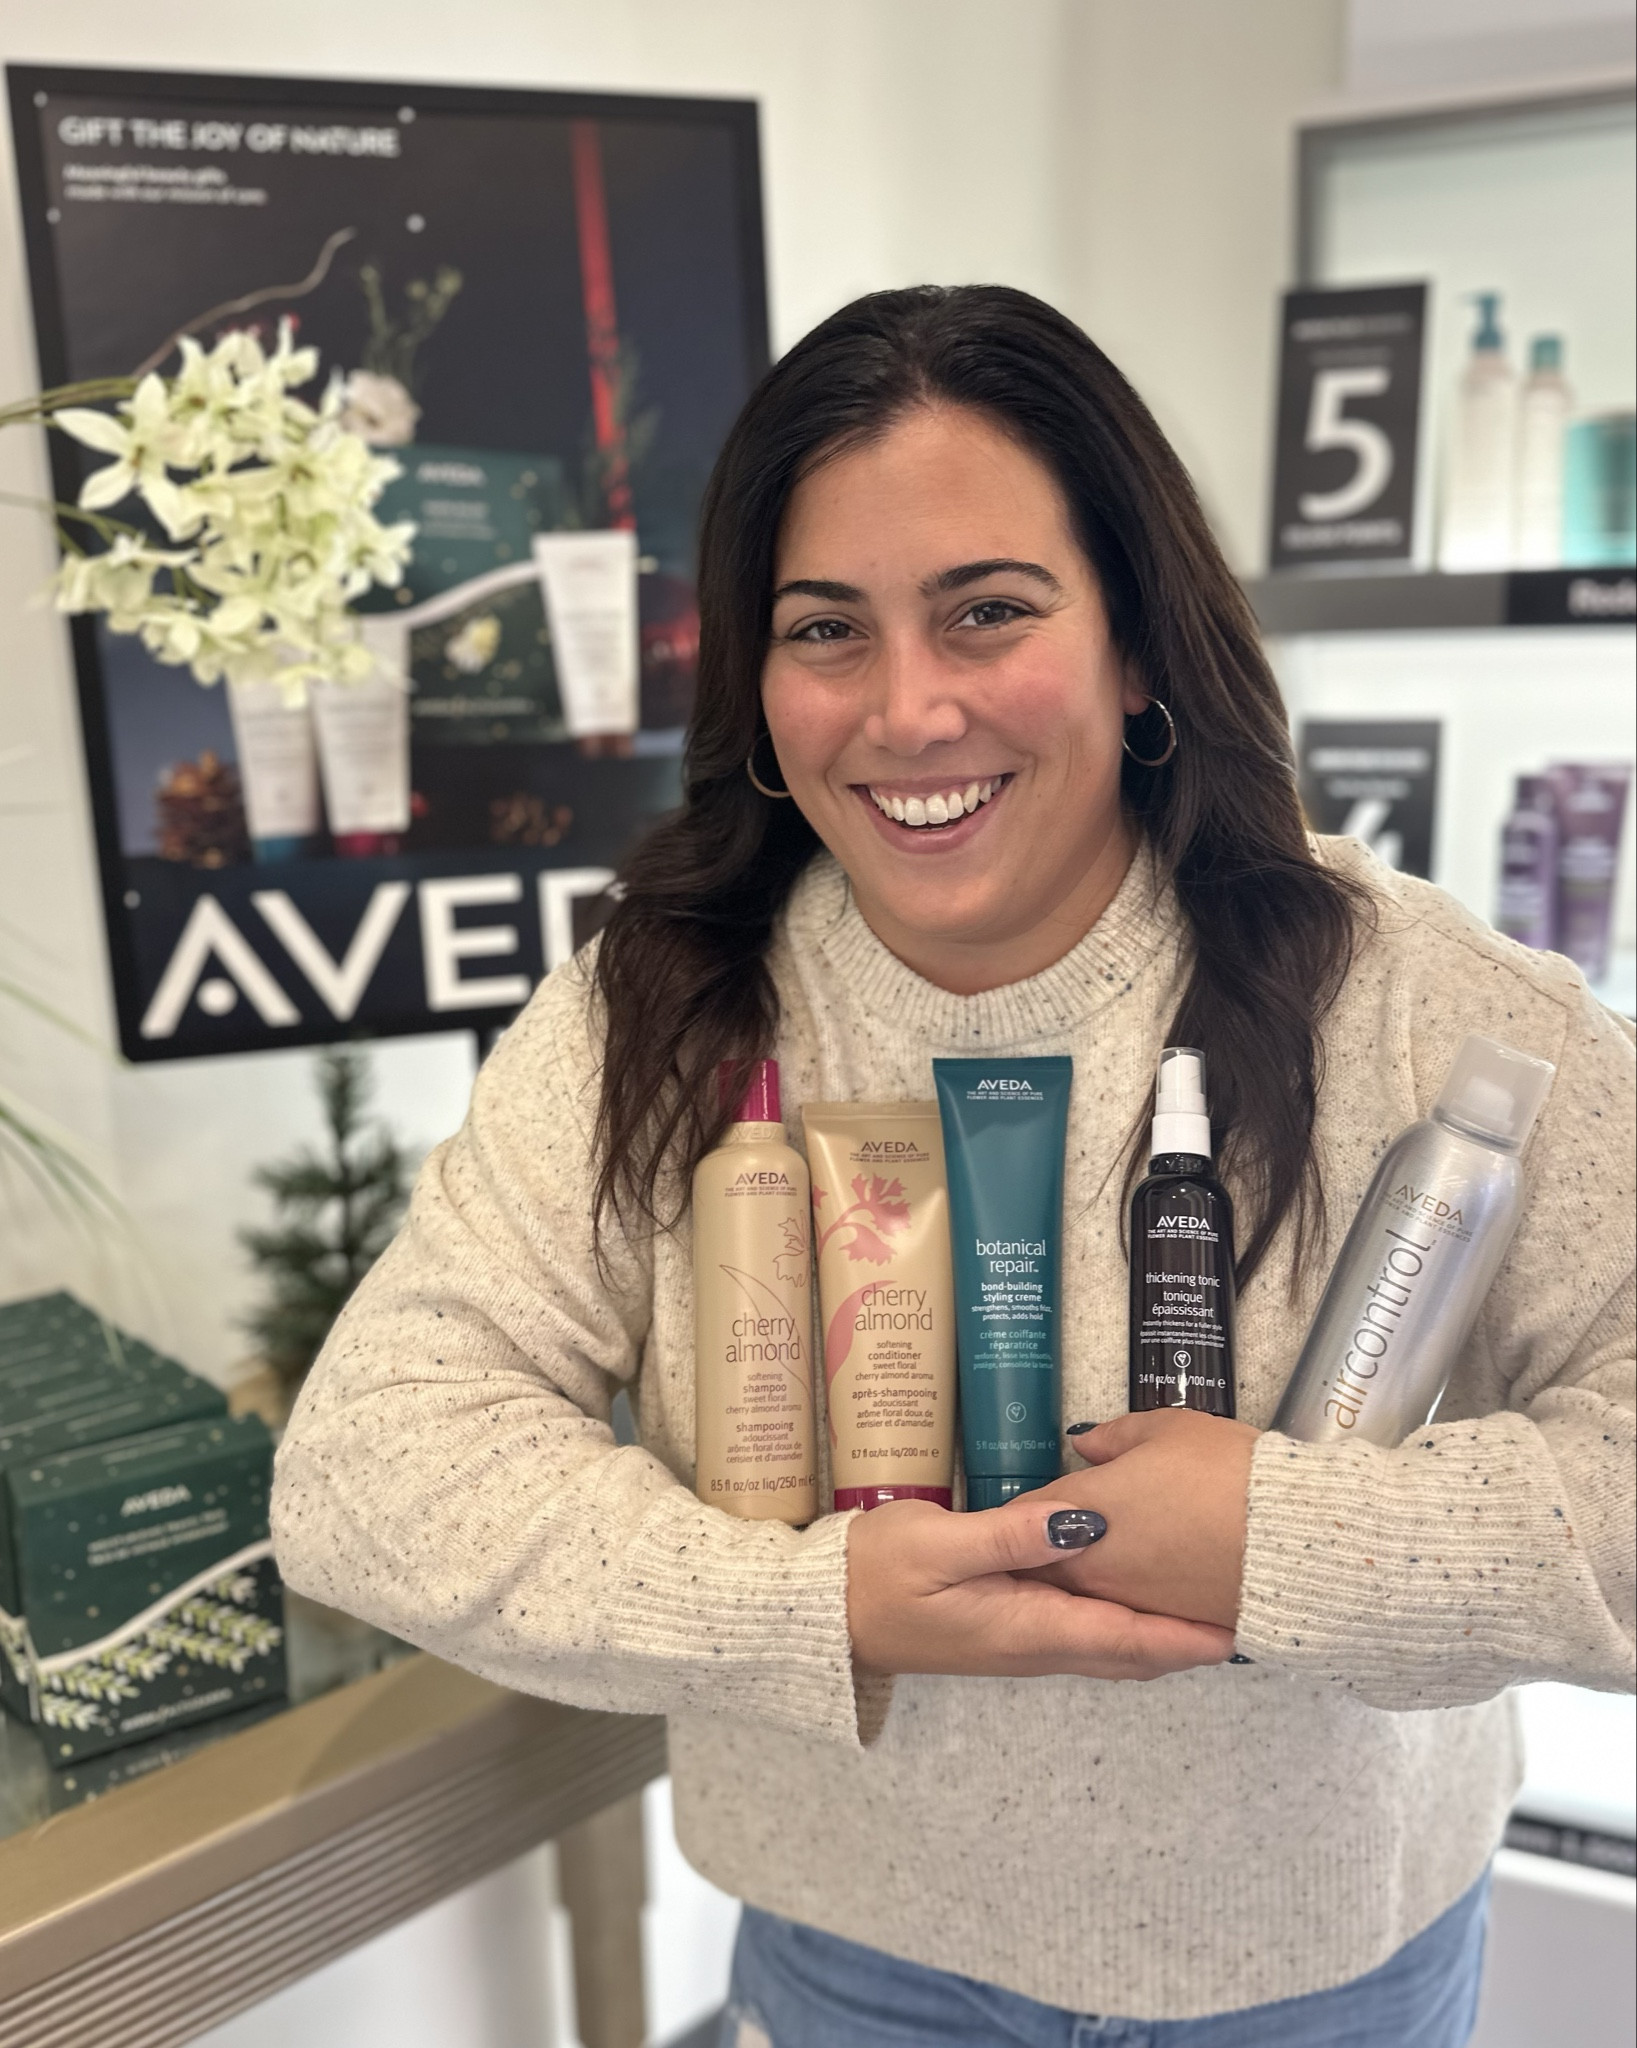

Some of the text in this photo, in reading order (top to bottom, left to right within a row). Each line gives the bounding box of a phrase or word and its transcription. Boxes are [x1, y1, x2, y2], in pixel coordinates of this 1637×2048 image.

[58, 115, 401, 158] GIFT THE JOY OF NATURE
[1298, 368, 1393, 521] 5
[977, 1079, 1032, 1090] AVEDA
[861, 1141, 918, 1153] AVEDA
[735, 1172, 789, 1185] AVEDA
[1395, 1184, 1463, 1225] AVEDA
[1156, 1216, 1210, 1230] AVEDA
[976, 1238, 1046, 1256] botanical
[1146, 1272, 1220, 1288] thickening tonic
[981, 1281, 1043, 1294] bond-building
[861, 1283, 927, 1312] cherry
[983, 1292, 1042, 1303] styling creme
[1163, 1290, 1203, 1304] tonique
[1152, 1303, 1214, 1318] épaississant
[855, 1307, 933, 1331] almond
[732, 1312, 796, 1341] cherry
[1322, 1228, 1432, 1430] aircontrol
[980, 1329, 1047, 1339] crème coiffante
[725, 1335, 800, 1362] almond
[876, 1340, 912, 1350] softening
[989, 1340, 1038, 1351] réparatrice
[868, 1350, 922, 1360] conditioner
[897, 1361, 917, 1370] floral
[747, 1372, 783, 1382] softening
[855, 1373, 879, 1382] cherry
[880, 1371, 909, 1380] almond
[1178, 1374, 1205, 1387] l/100
[1206, 1378, 1215, 1387] ml
[743, 1383, 787, 1394] shampoo
[852, 1387, 938, 1401] après-shampooing
[743, 1393, 787, 1403] sweet floral
[873, 1399, 919, 1407] adoucissant
[725, 1405, 749, 1415] cherry
[751, 1404, 780, 1413] almond
[857, 1408, 933, 1418] arôme floral doux de
[736, 1421, 794, 1433] shampooing
[856, 1420, 883, 1429] cerisier
[884, 1419, 893, 1427] et
[742, 1432, 789, 1442] adoucissant
[752, 1443, 773, 1452] floral
[774, 1442, 793, 1451] doux
[919, 1448, 929, 1457] ml
[726, 1454, 754, 1464] cerisier
[754, 1454, 763, 1463] et
[724, 1478, 731, 1491] fl
[733, 1478, 760, 1493] oz/oz
[762, 1475, 797, 1492] liq/250
[798, 1475, 808, 1487] ml
